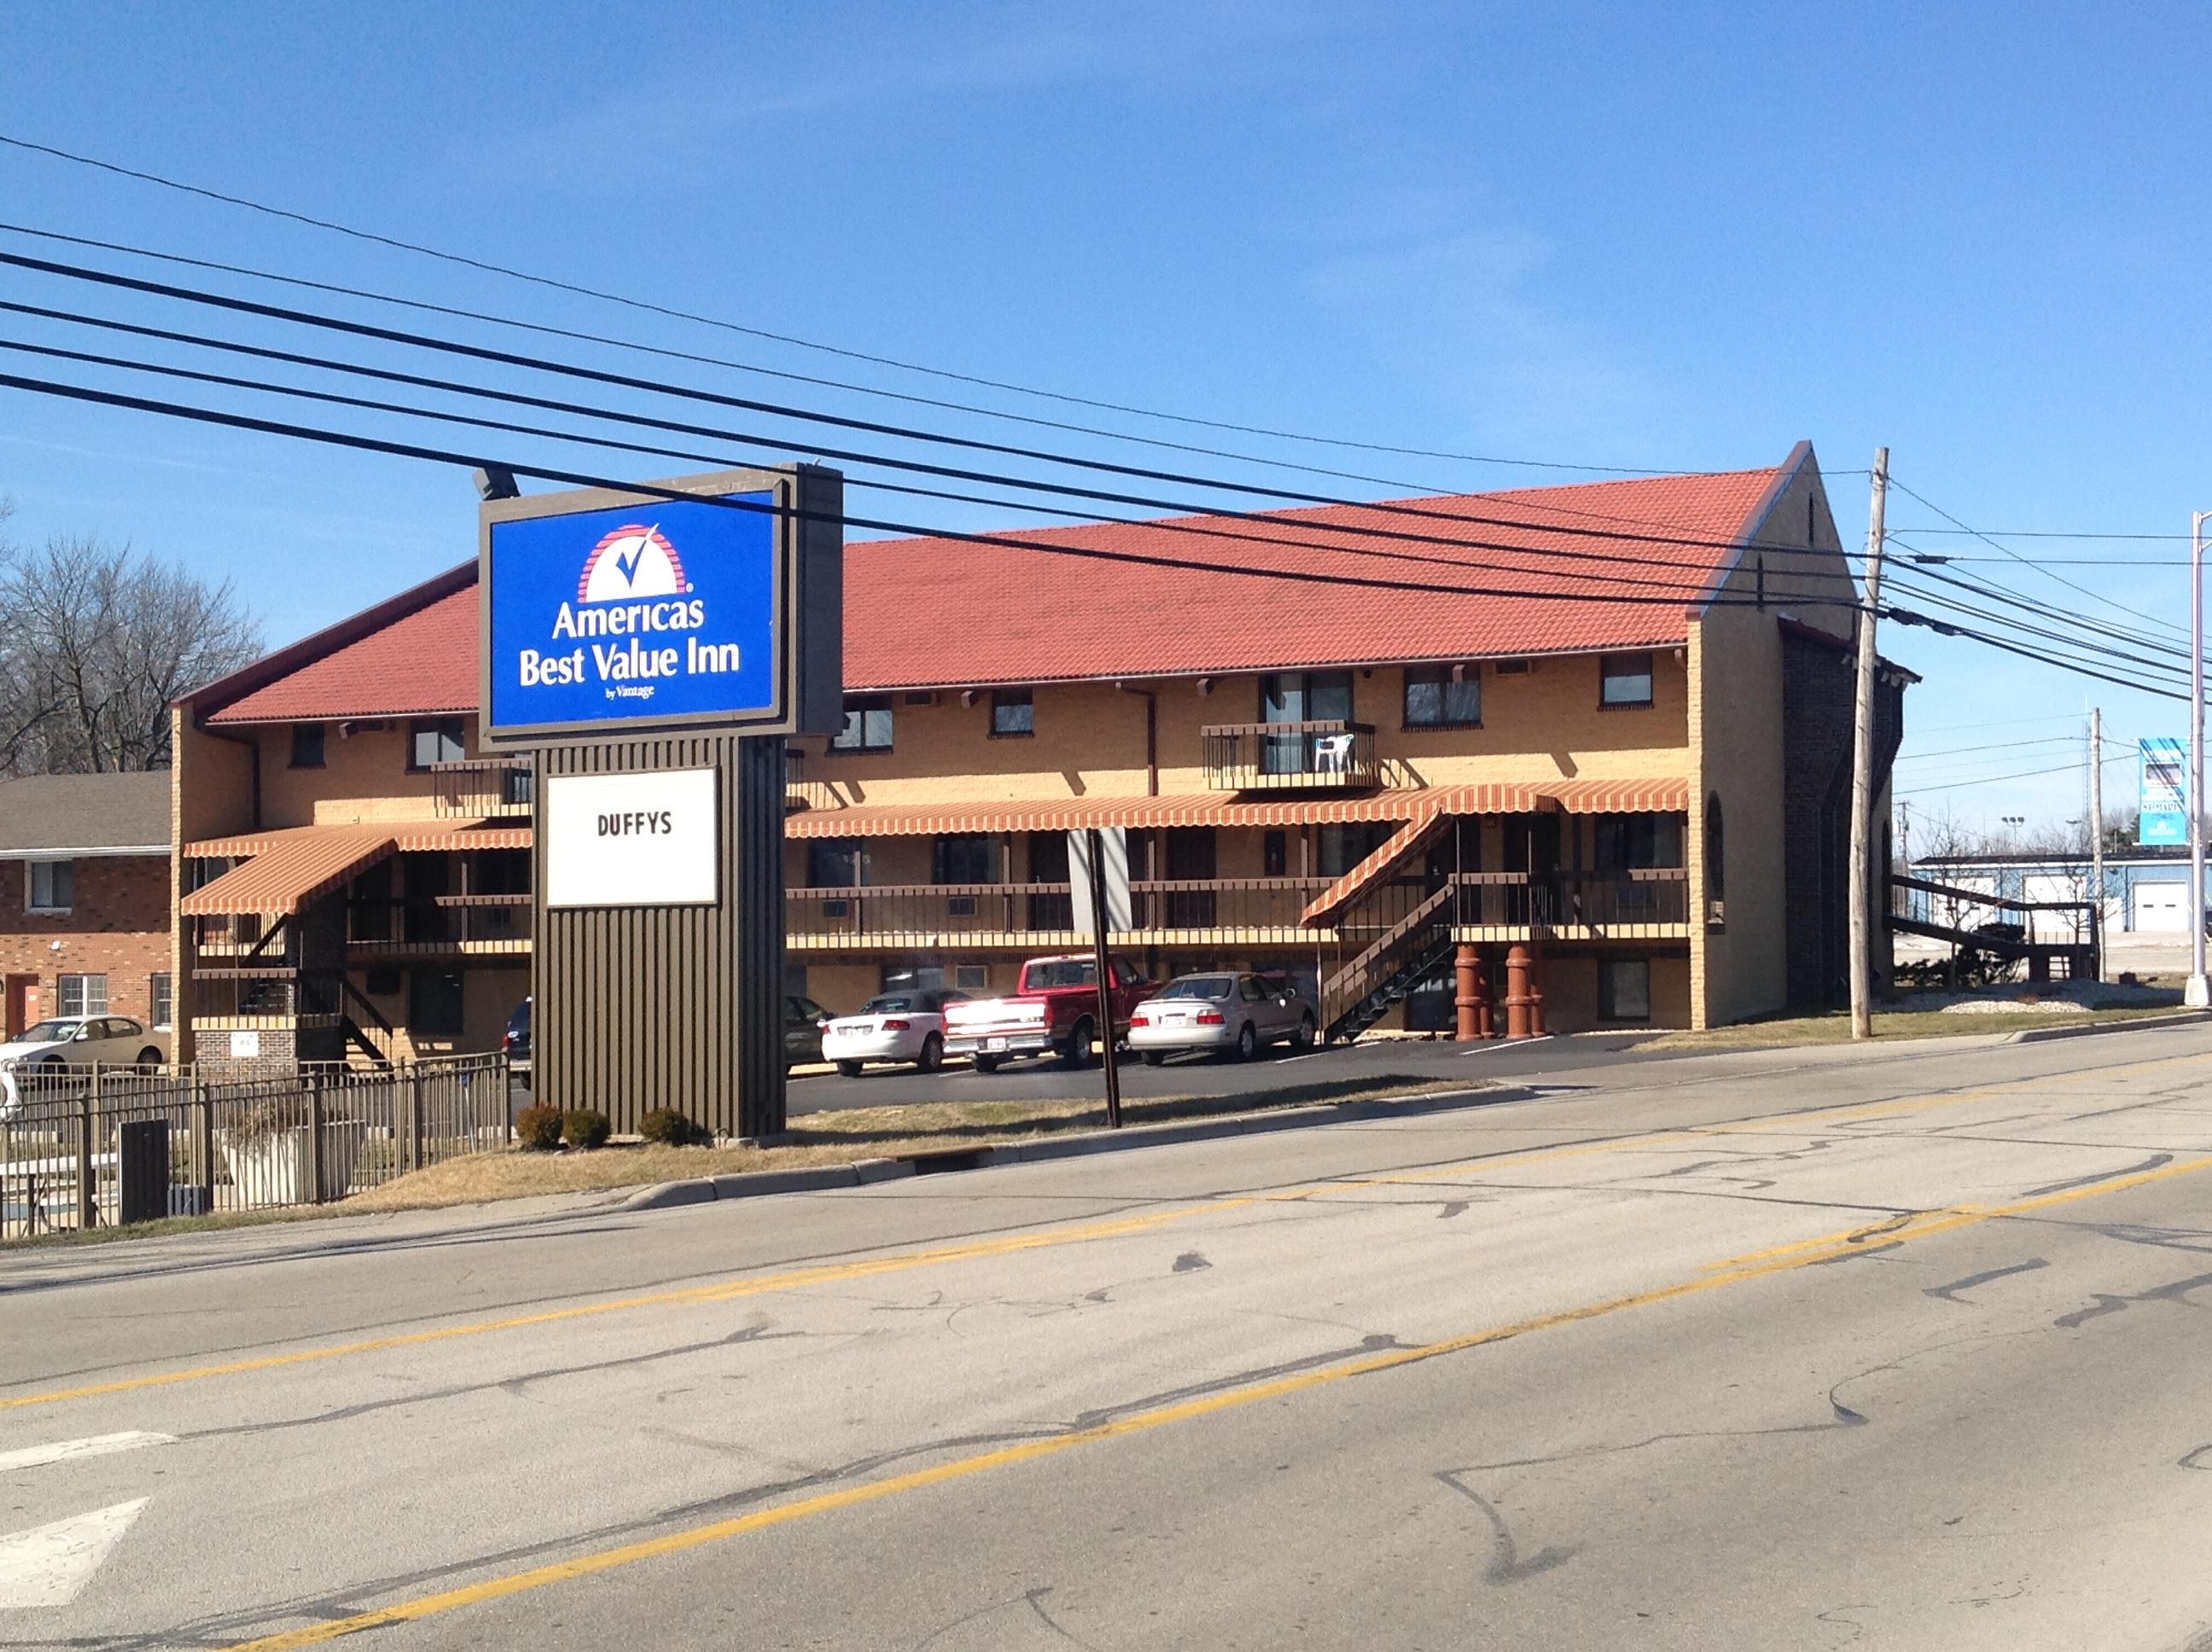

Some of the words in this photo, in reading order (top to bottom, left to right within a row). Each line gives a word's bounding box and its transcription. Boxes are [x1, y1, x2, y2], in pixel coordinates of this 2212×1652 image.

[552, 599, 703, 639] Americas
[520, 649, 585, 686] Best
[592, 637, 677, 680] Value
[688, 637, 739, 674] Inn
[605, 688, 615, 700] by
[598, 811, 672, 836] DUFFYS
